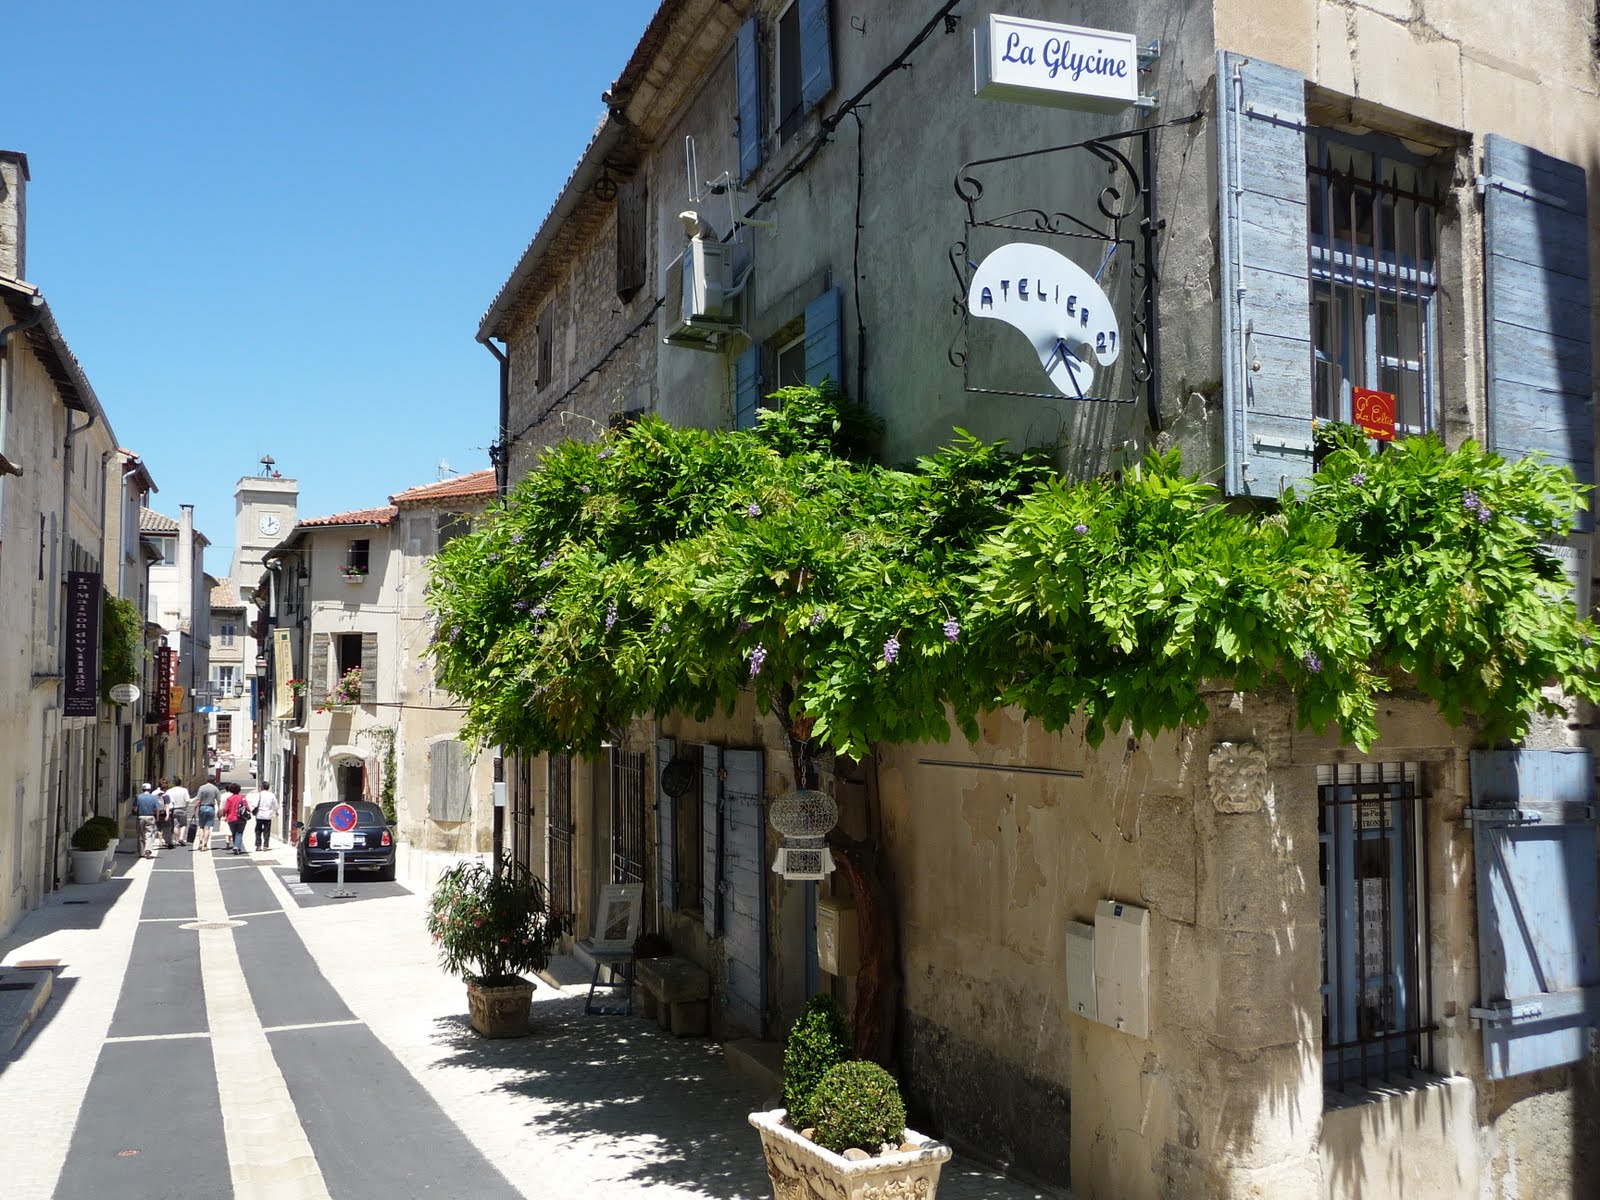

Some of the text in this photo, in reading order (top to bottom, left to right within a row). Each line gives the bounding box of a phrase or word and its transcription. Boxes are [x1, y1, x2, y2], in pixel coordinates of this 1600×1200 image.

[1001, 32, 1128, 82] La Glycine
[980, 278, 1090, 327] ATELIER
[1096, 331, 1116, 353] 27
[1355, 396, 1370, 421] La
[77, 577, 90, 590] La
[76, 592, 90, 629] Maison
[75, 631, 86, 644] du
[74, 647, 86, 693] village
[160, 651, 168, 713] RESTAURANT
